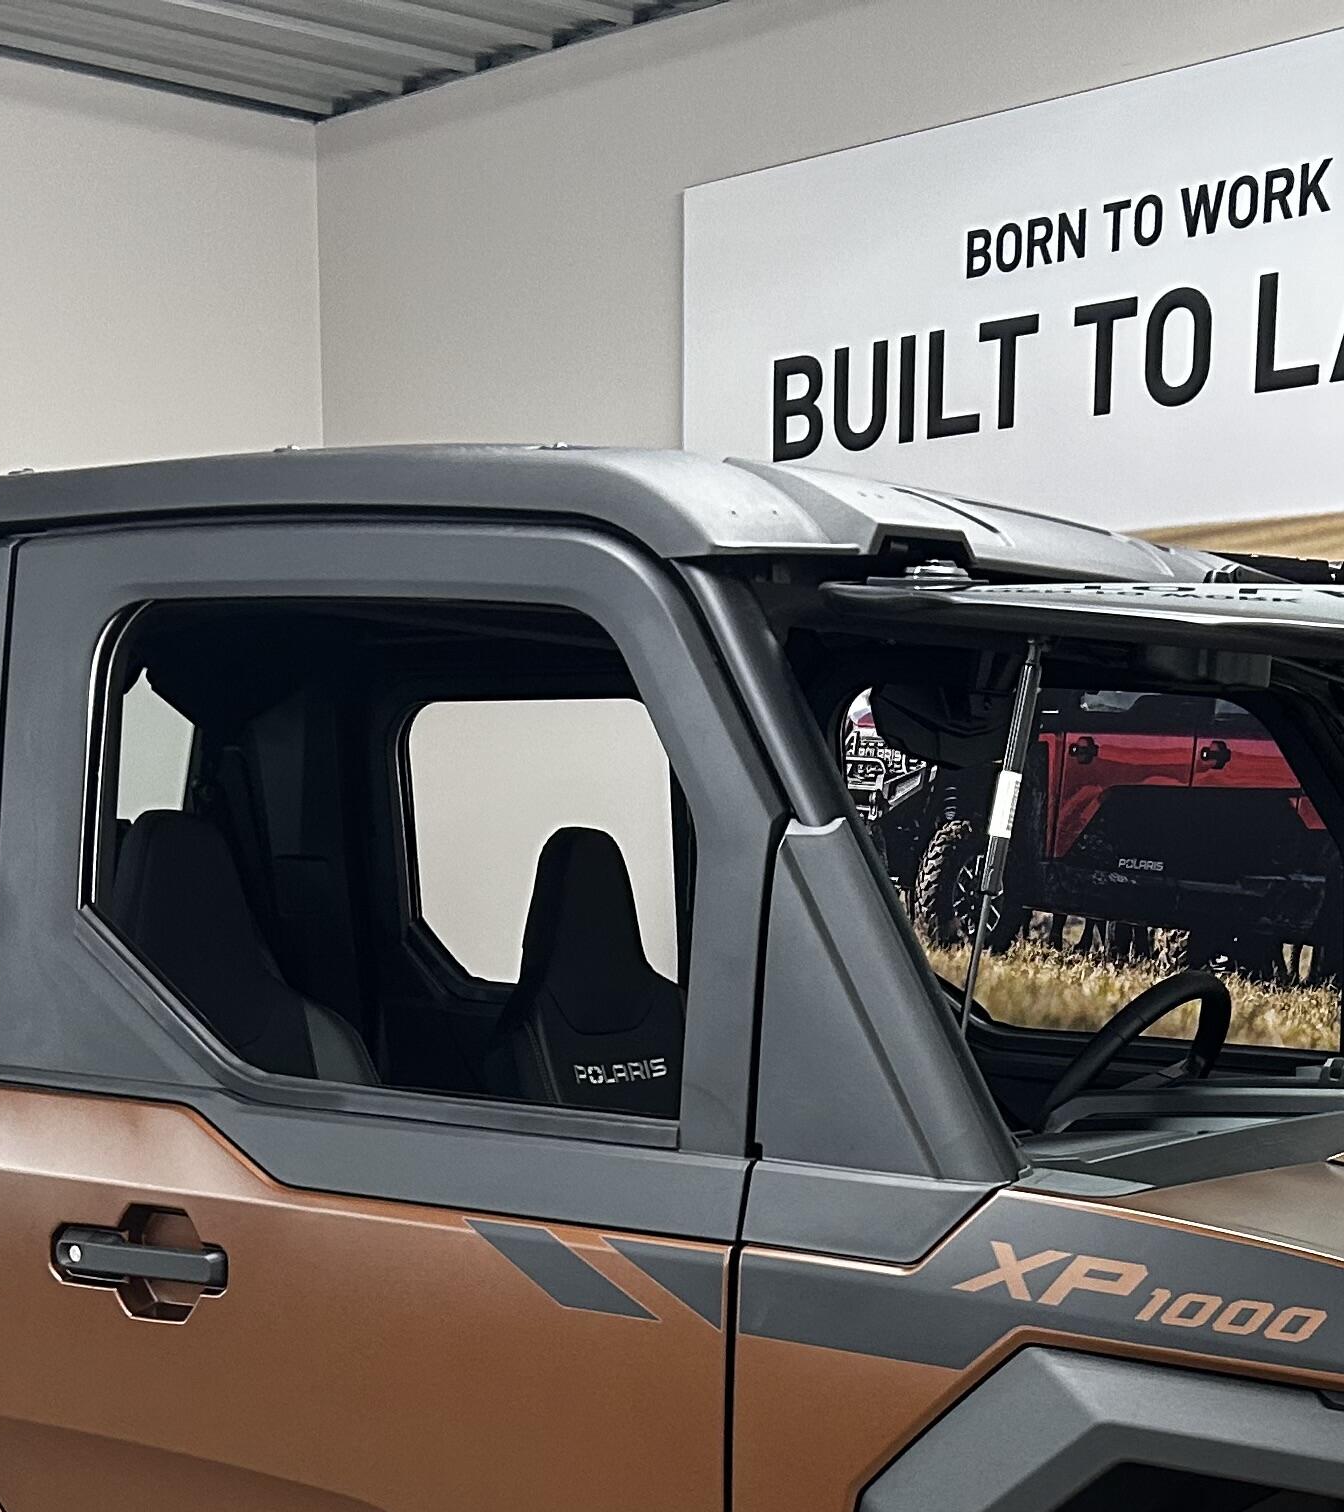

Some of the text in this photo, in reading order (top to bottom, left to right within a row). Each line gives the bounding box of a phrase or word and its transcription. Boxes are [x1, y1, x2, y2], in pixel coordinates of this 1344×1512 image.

[966, 157, 1334, 280] BORN TO WORK
[771, 312, 1041, 463] BUILT
[1073, 285, 1213, 417] TO
[1118, 858, 1164, 872] POLARIS
[573, 1057, 668, 1085] POLARIS
[951, 1240, 1328, 1344] XP 1000
